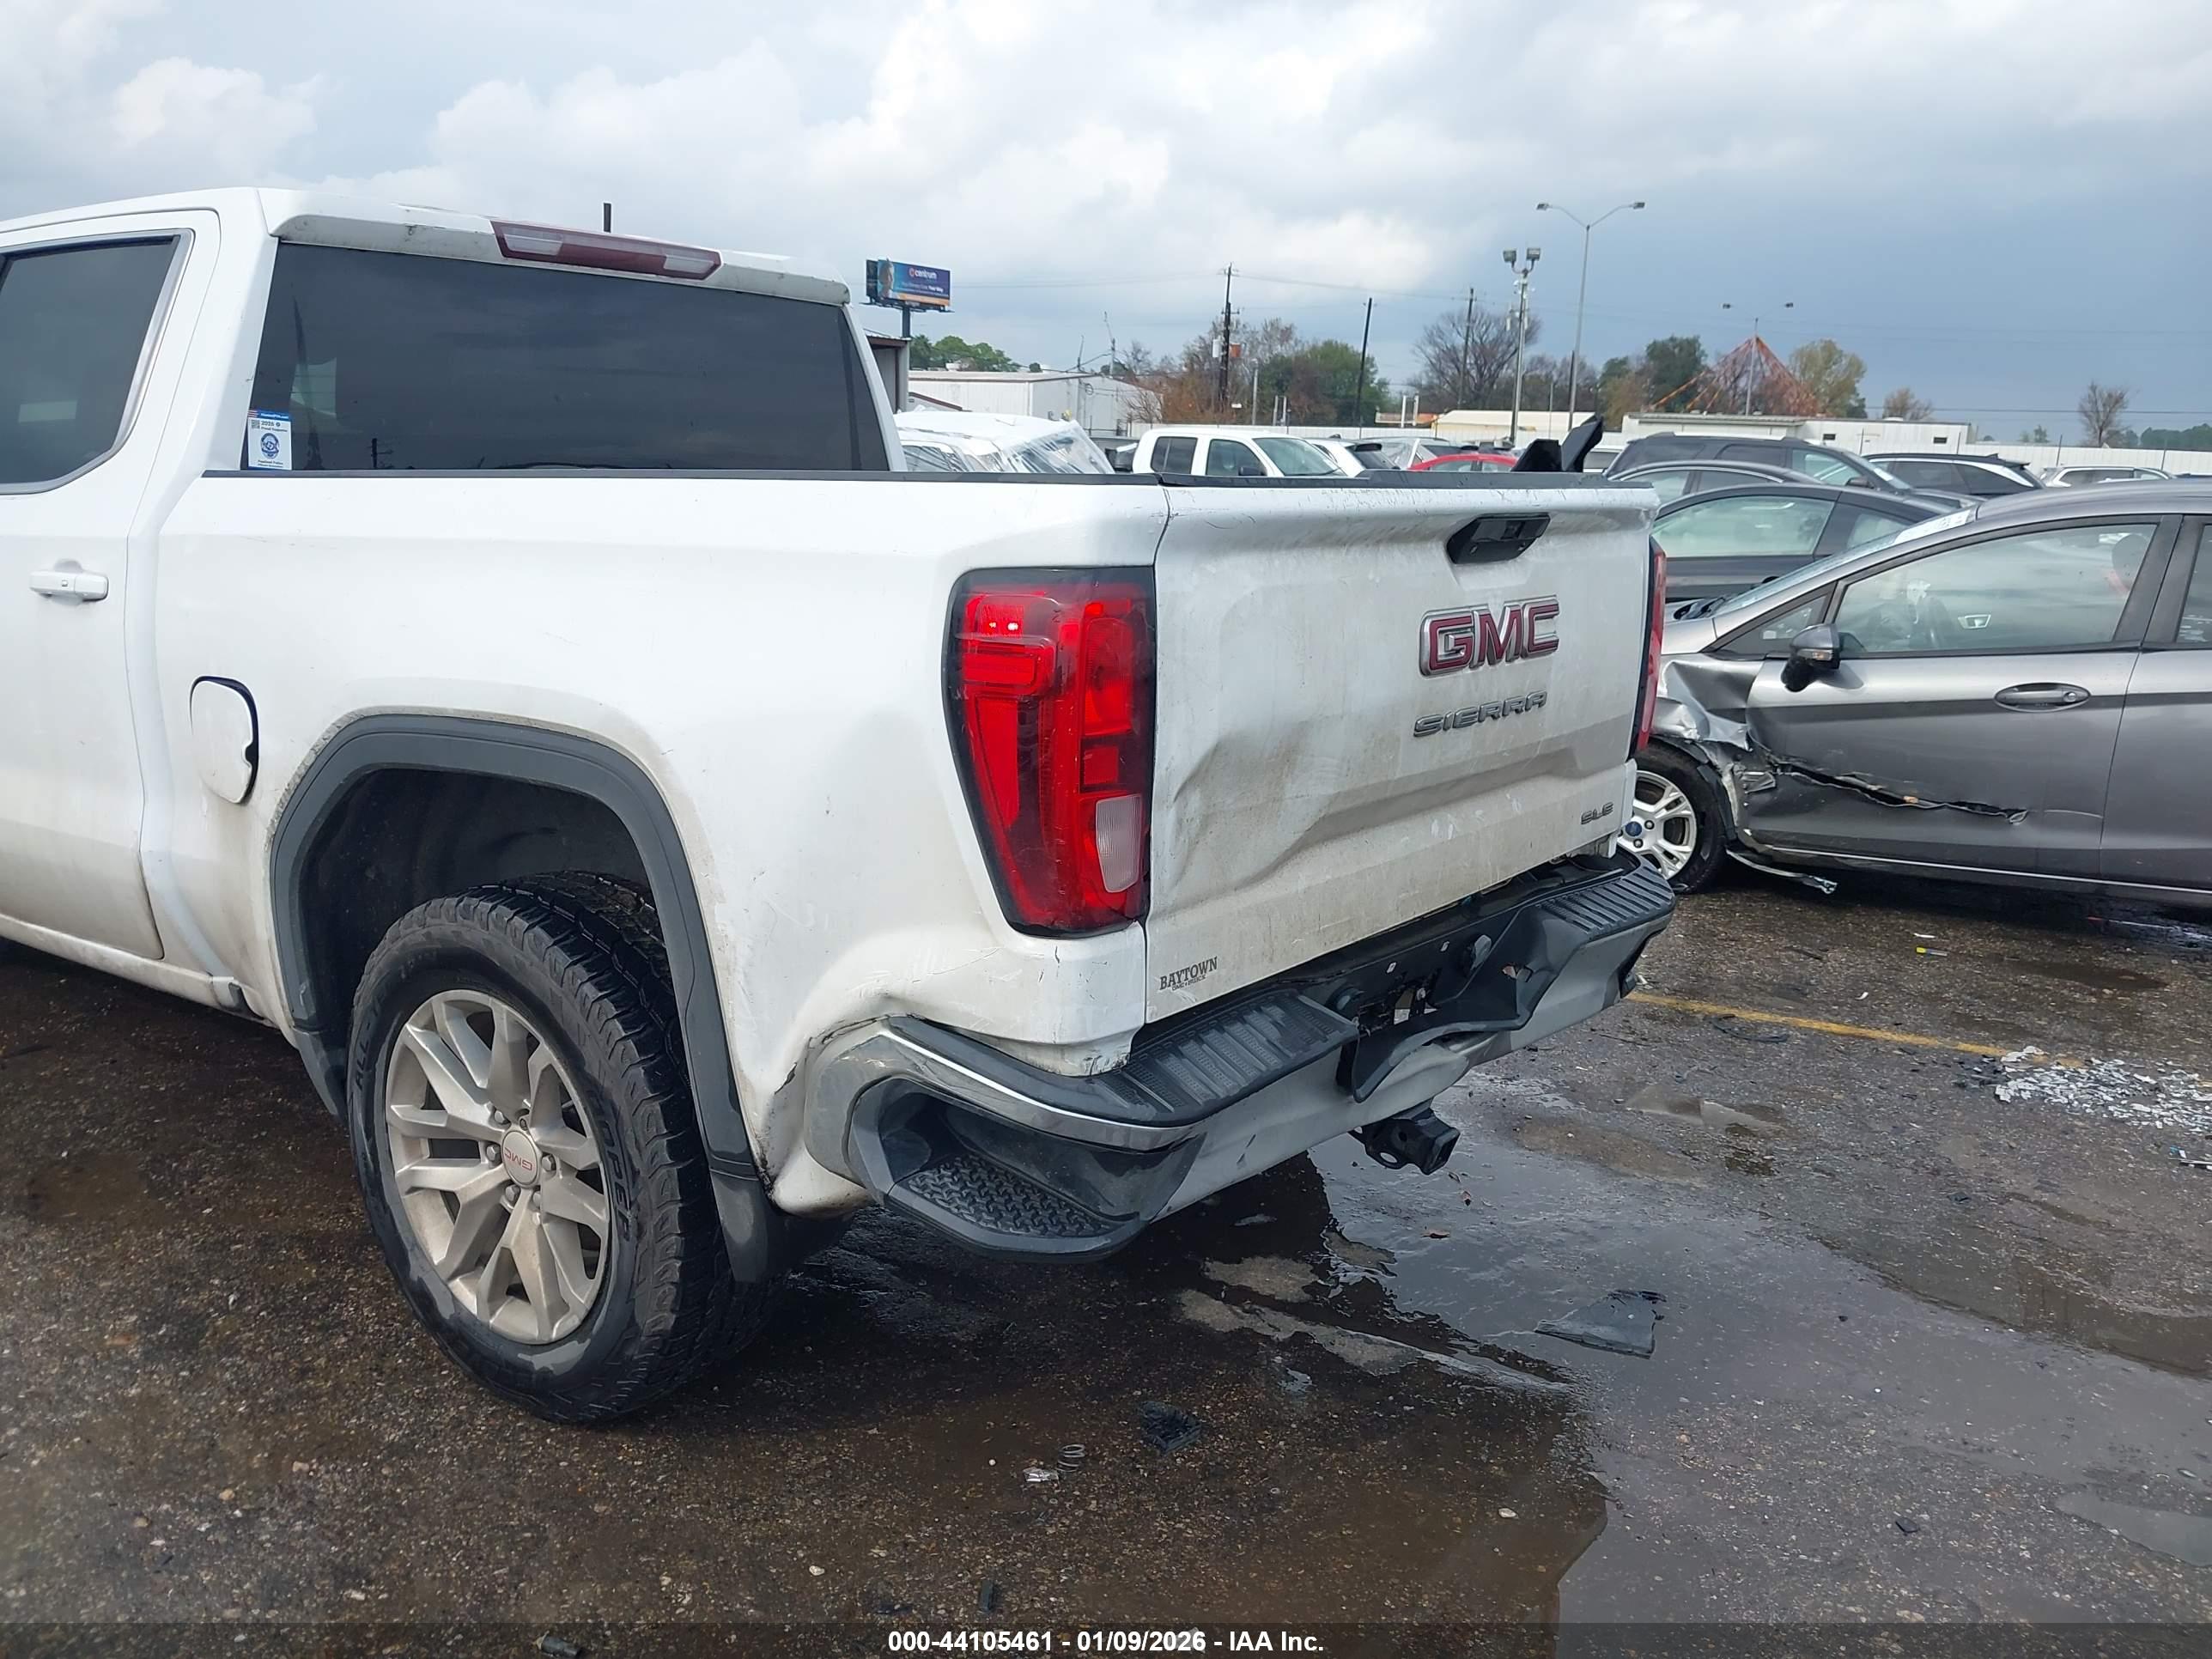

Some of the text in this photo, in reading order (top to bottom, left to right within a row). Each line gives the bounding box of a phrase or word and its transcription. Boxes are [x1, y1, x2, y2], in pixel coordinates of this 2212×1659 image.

[1419, 594, 1561, 678] GMC
[1413, 690, 1548, 738] SIERRA
[1580, 802, 1614, 825] SLE
[1159, 957, 1218, 990] BAYTOWN
[504, 1147, 533, 1171] GMC
